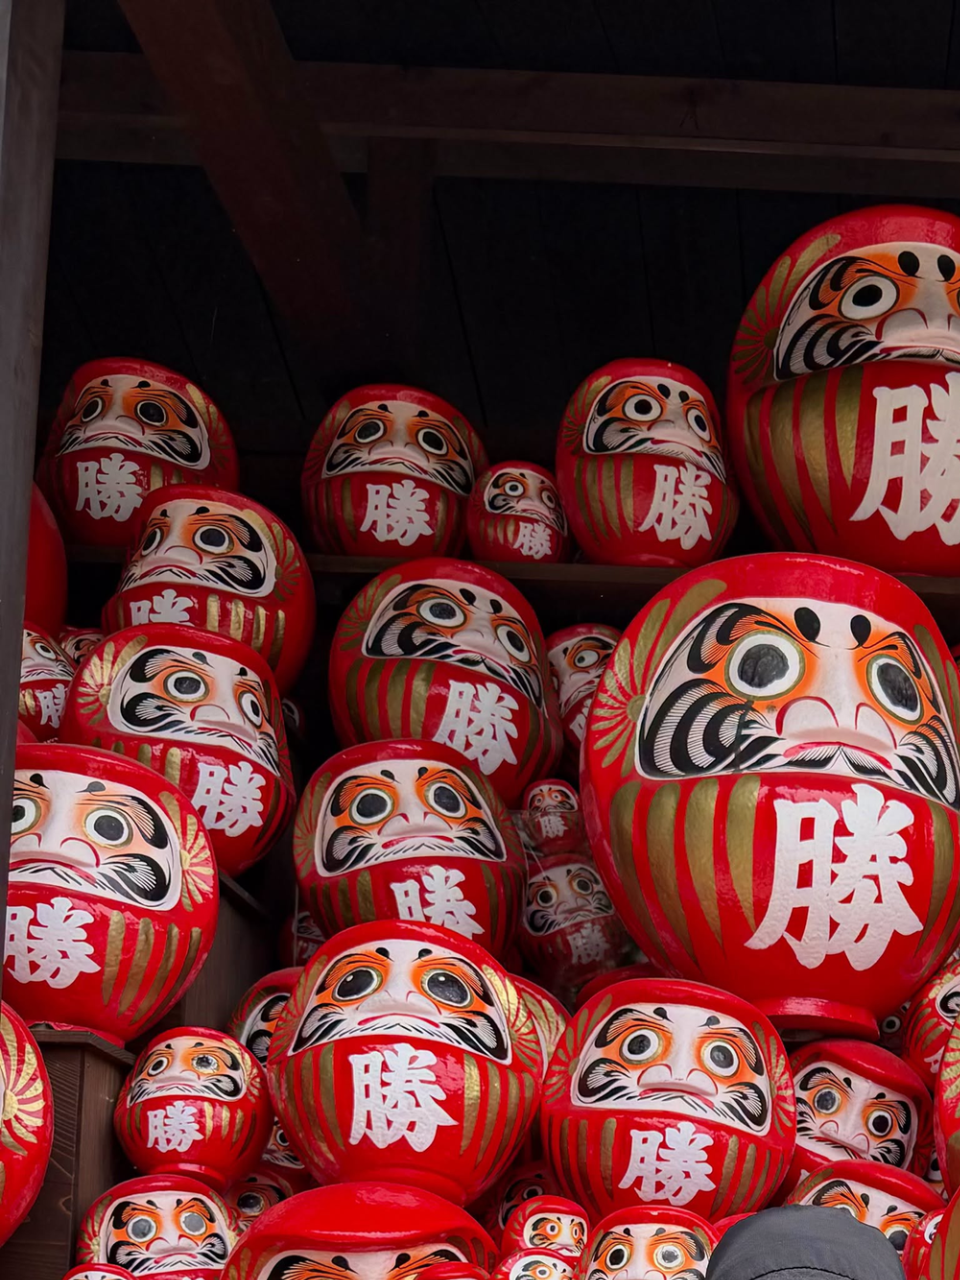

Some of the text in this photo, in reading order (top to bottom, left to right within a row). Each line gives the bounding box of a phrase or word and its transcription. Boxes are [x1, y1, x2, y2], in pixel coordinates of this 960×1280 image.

[76, 453, 143, 522] 勝
[361, 479, 434, 546] 勝
[638, 461, 712, 550] 勝
[513, 521, 552, 559] 勝
[432, 679, 519, 775] 勝
[191, 761, 266, 837] 勝
[390, 865, 485, 939] 勝
[744, 783, 924, 971] 勝
[4, 896, 101, 989] 勝
[567, 923, 606, 964] 勝
[147, 1101, 204, 1153] 勝
[348, 1043, 459, 1153] 勝
[618, 1121, 716, 1205] 勝
